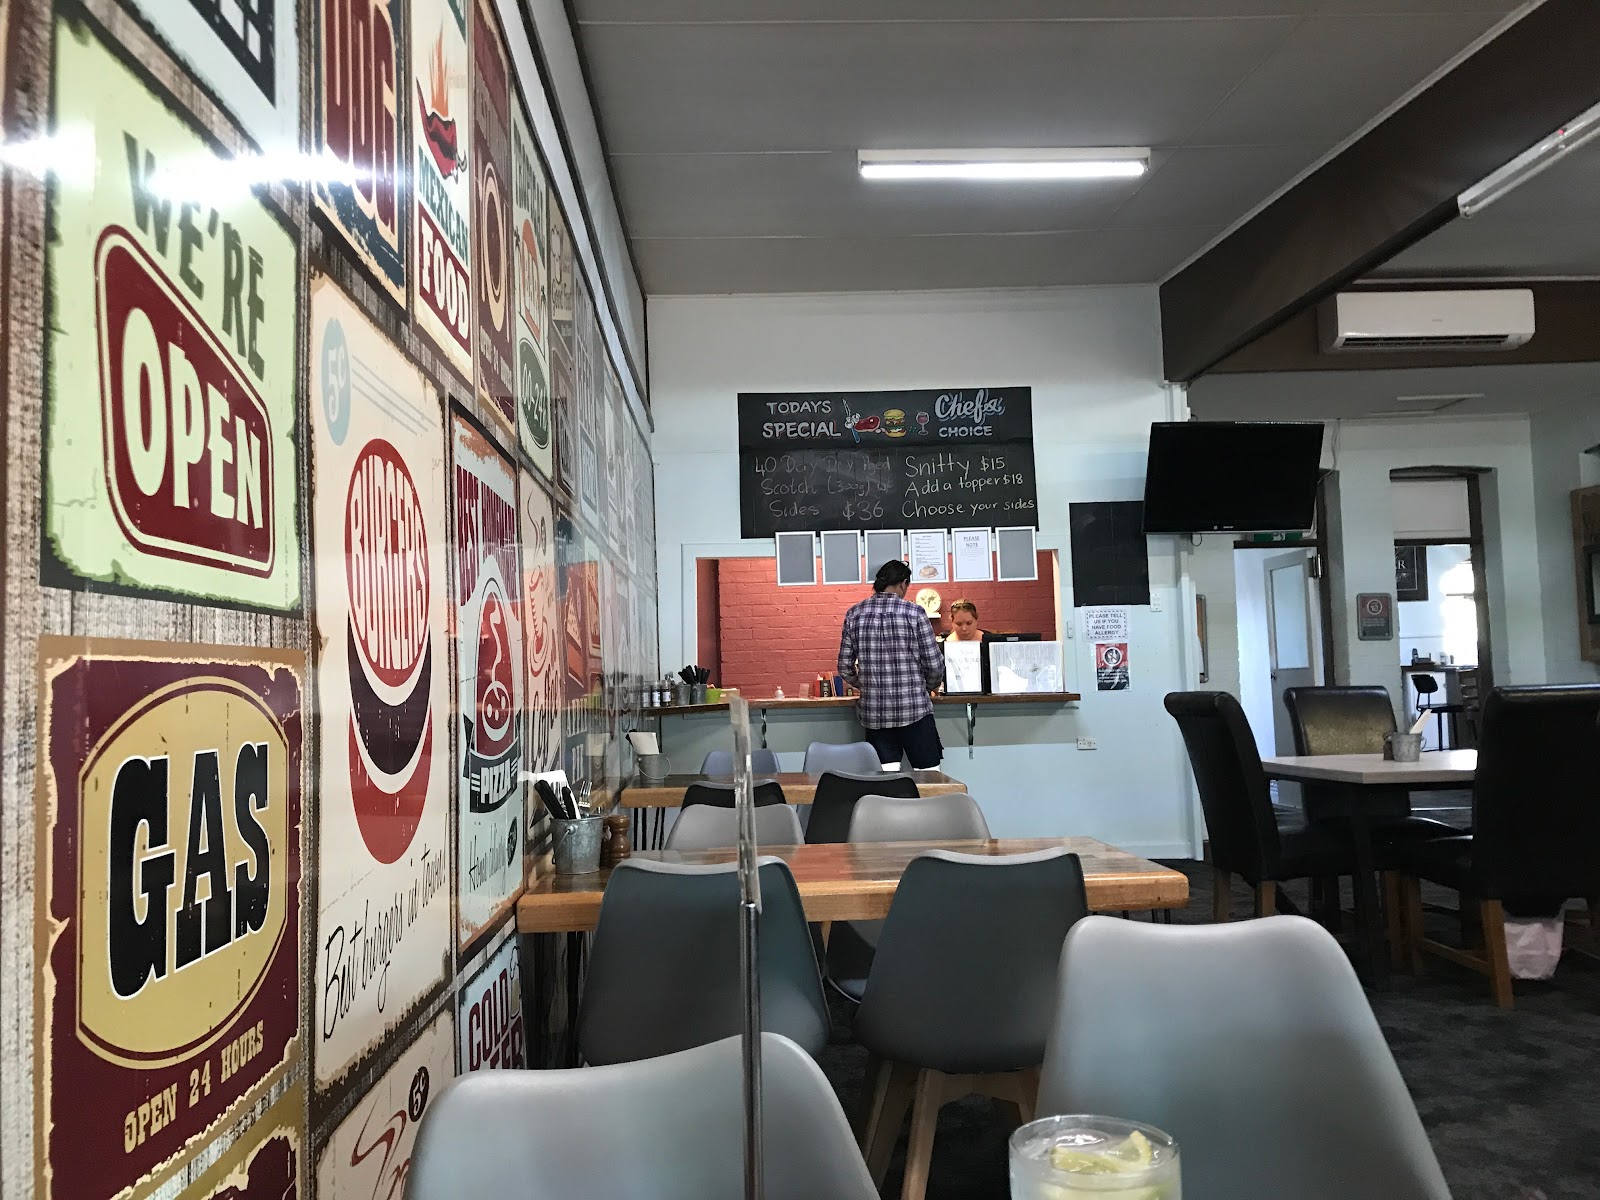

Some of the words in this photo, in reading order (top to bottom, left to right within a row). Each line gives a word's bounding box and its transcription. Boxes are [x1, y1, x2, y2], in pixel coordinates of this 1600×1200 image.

[418, 144, 469, 267] MEXICAN
[420, 216, 470, 340] FOOD
[121, 306, 262, 530] OPEN
[762, 421, 841, 439] SPECIAL
[766, 400, 832, 415] TODAYS
[938, 425, 993, 438] CHOICE
[755, 456, 777, 477] 40
[760, 475, 820, 495] Scotch
[904, 479, 939, 497] Add
[943, 482, 952, 490] a
[958, 476, 1000, 493] topper
[1002, 473, 1023, 485] $18
[905, 452, 970, 480] Snitty
[980, 455, 1006, 472] $15
[769, 500, 820, 517] Sides
[842, 500, 884, 521] $36
[902, 500, 964, 518] Choose
[970, 502, 998, 517] your
[1003, 498, 1035, 511] sides
[456, 464, 480, 607] BEST
[350, 454, 428, 672] BURGERS
[480, 758, 511, 805] PIZZA
[107, 741, 270, 1000] GAS
[324, 921, 363, 1042] Best
[362, 898, 404, 1013] burgers
[468, 968, 509, 1071] COLD
[124, 1082, 178, 1153] OPEN
[189, 1065, 212, 1109] 24
[221, 1019, 264, 1084] HOURS
